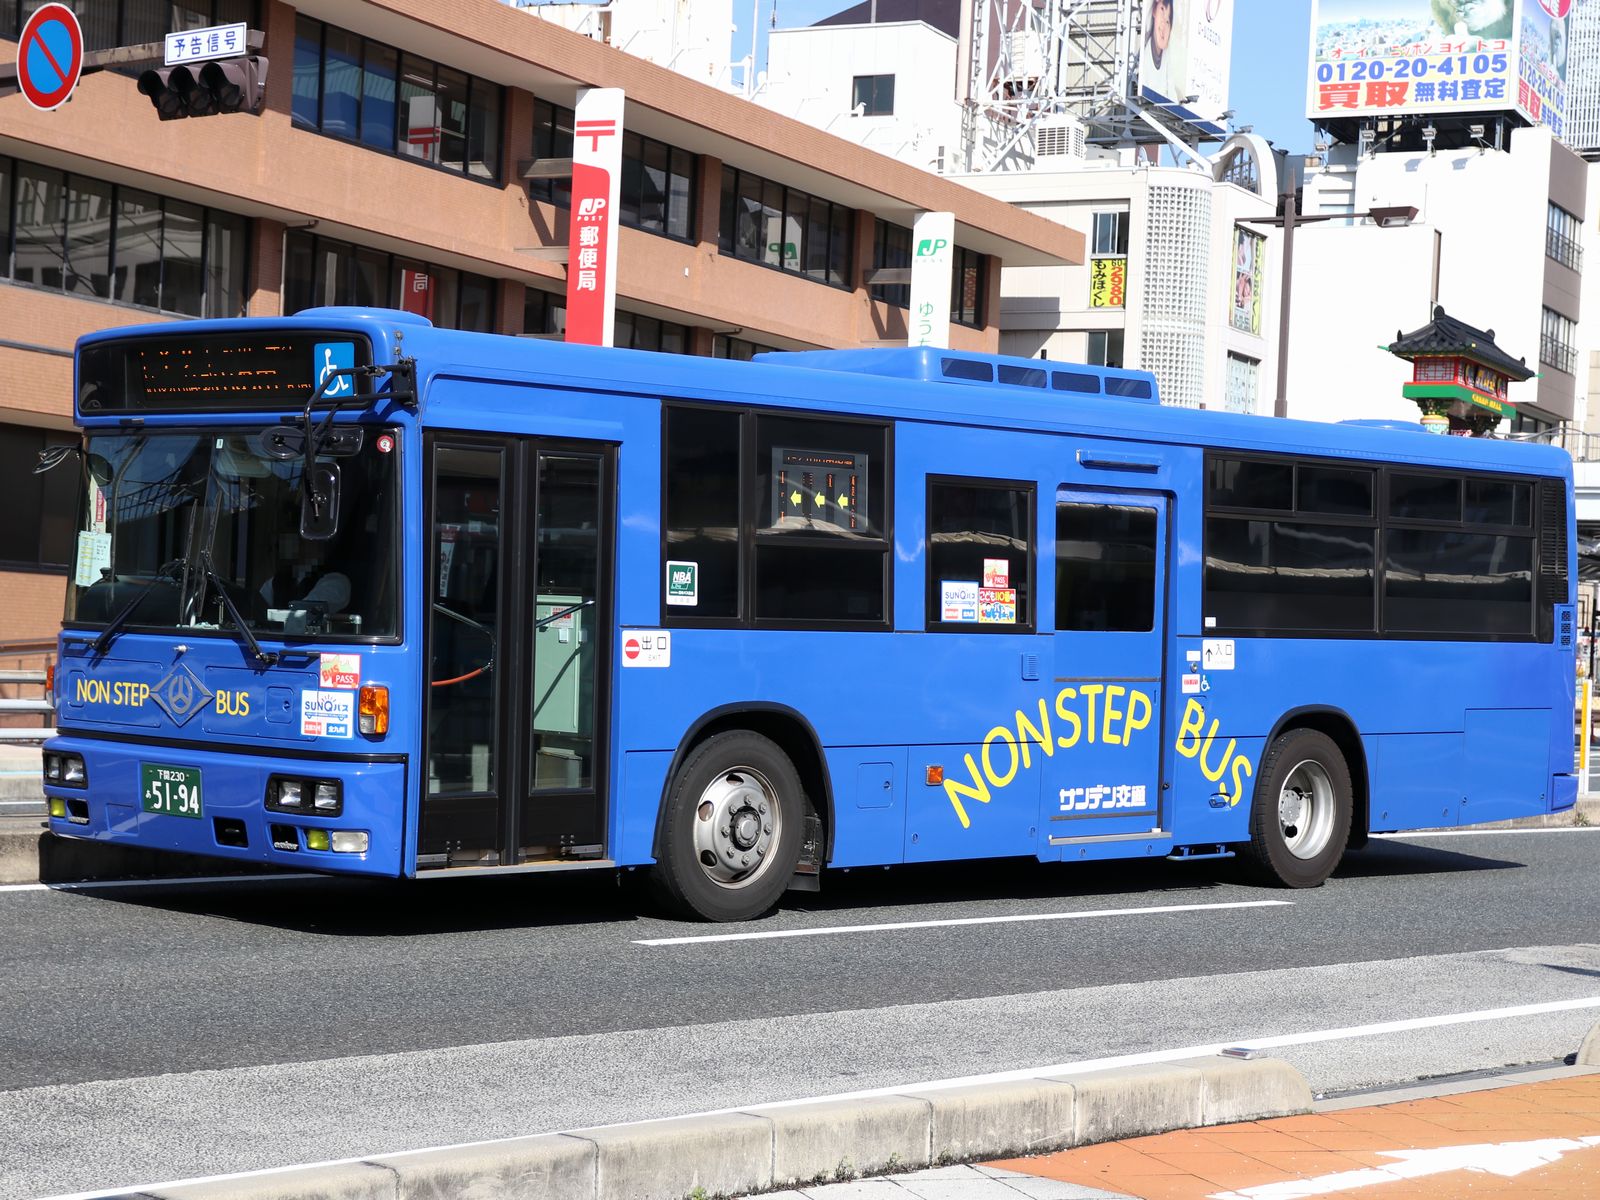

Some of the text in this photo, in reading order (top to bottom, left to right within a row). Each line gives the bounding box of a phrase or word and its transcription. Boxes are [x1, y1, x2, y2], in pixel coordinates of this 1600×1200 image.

[174, 31, 237, 58] 予告信号
[1317, 54, 1507, 82] 0120-20-4105
[1318, 78, 1506, 110] 買取 無料査定
[579, 198, 606, 216] JP
[577, 226, 599, 291] 郵便局
[916, 239, 947, 256] JP
[1093, 259, 1107, 307] もみほぐし
[1110, 267, 1123, 305] 2980
[673, 571, 691, 583] NBA
[642, 635, 667, 650] 出口
[1216, 643, 1232, 655] 入口
[335, 675, 354, 683] PASS
[76, 678, 249, 716] NON STEP BUS
[1176, 698, 1252, 807] BUS
[152, 781, 199, 814] 51-94
[1059, 785, 1146, 811] サンデン交通
